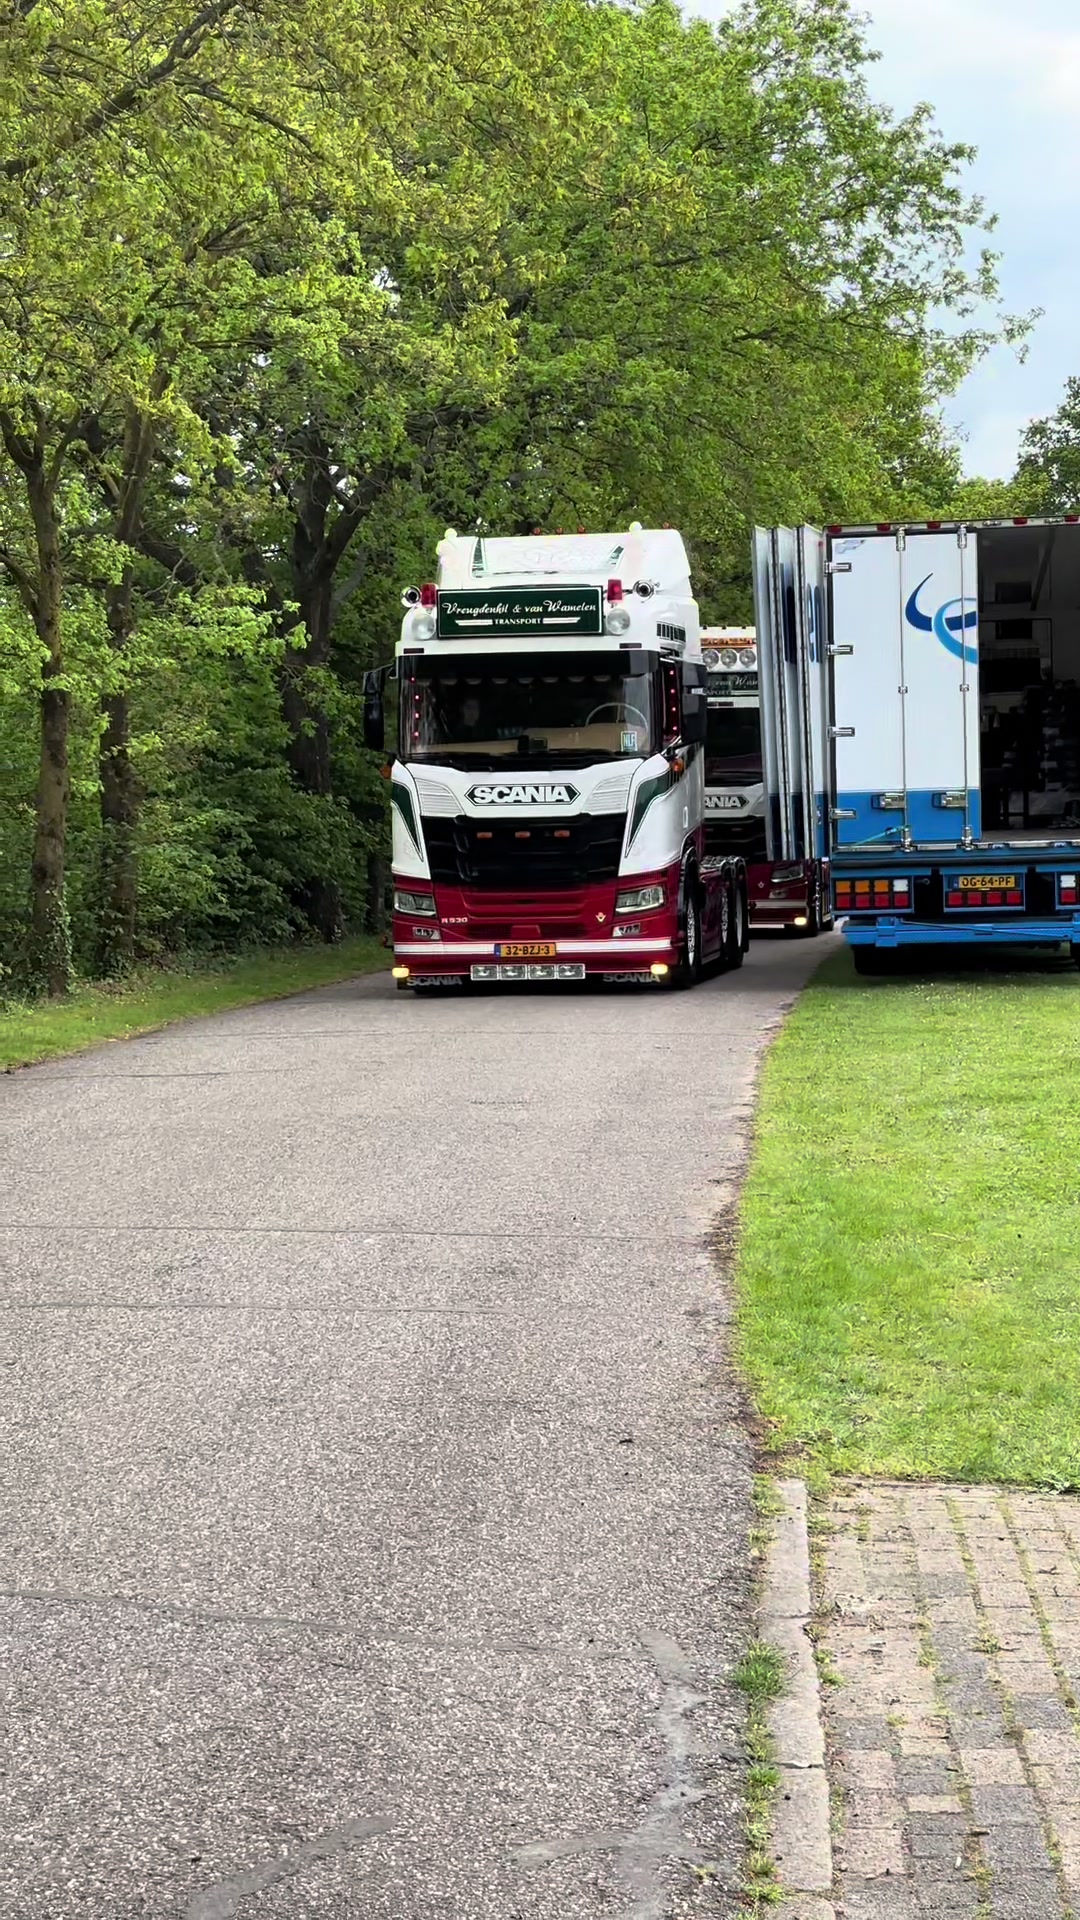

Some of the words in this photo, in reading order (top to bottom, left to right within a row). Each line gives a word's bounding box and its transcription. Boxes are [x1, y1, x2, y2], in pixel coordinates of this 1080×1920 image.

[441, 603, 508, 617] Vreugdenhil
[512, 604, 521, 613] &
[543, 600, 596, 612] Wamelen
[494, 617, 541, 625] TRANSPORT
[473, 786, 570, 803] SCANIA
[505, 945, 550, 956] 32-BZJ-3
[406, 976, 462, 986] SCANIA
[603, 973, 661, 983] SCANIA
